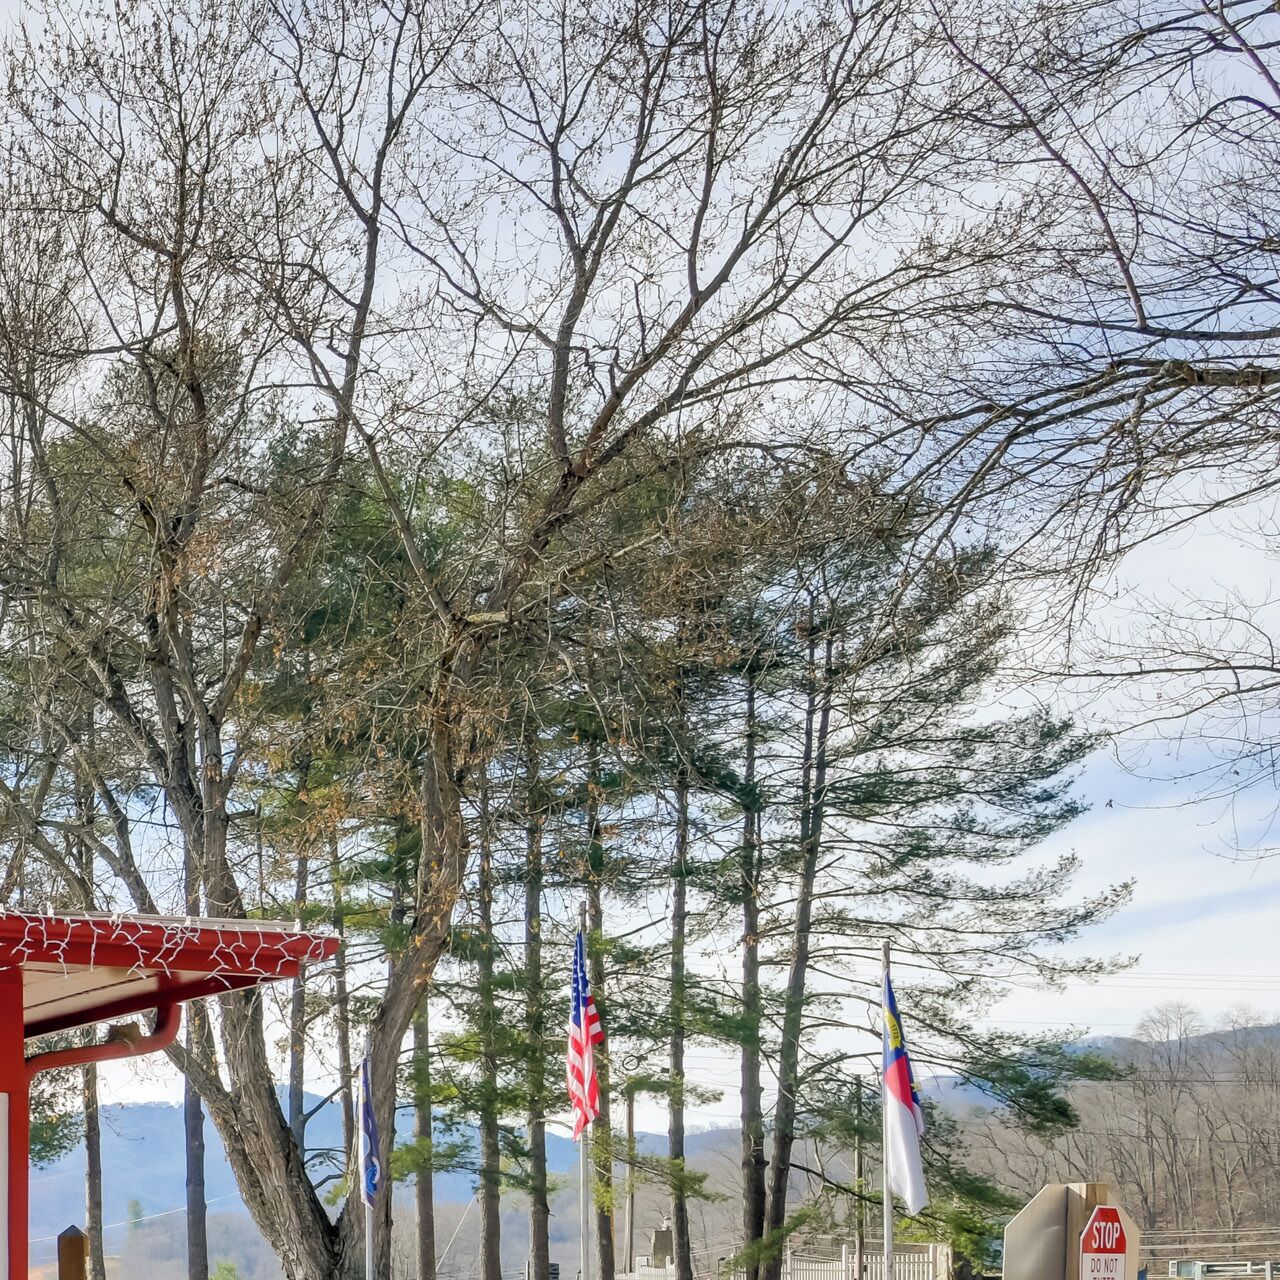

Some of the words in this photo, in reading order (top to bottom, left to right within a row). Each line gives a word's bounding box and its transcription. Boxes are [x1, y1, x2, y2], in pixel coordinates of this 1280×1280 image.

[1091, 1221, 1121, 1249] STOP
[1091, 1258, 1101, 1273] DO
[1104, 1258, 1118, 1273] NOT
